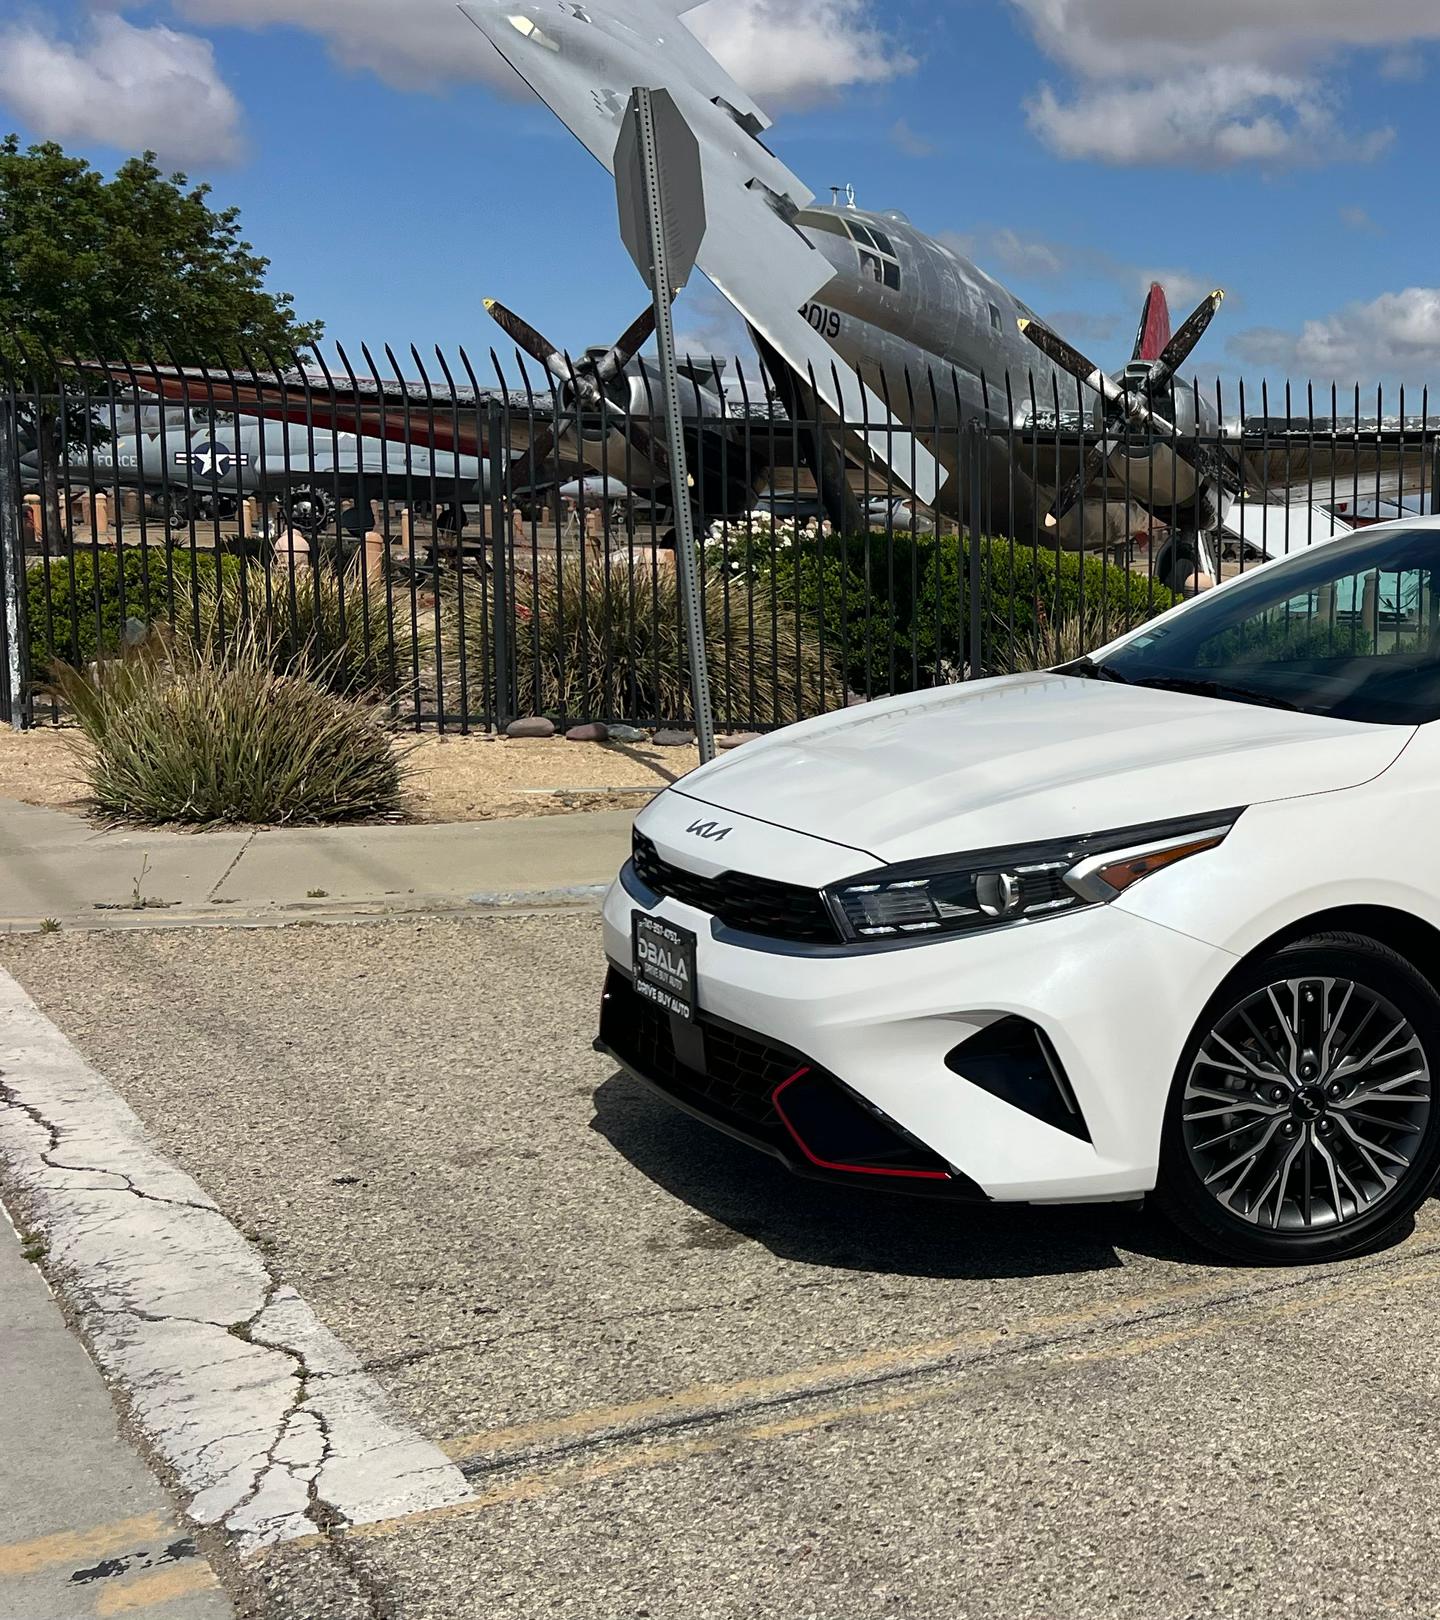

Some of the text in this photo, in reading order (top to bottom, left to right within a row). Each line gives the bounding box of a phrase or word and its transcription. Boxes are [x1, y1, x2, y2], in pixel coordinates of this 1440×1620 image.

[686, 818, 733, 842] KIA
[638, 937, 689, 982] DBALA
[658, 969, 670, 984] BUY
[669, 975, 683, 991] AUTO
[637, 979, 690, 1019] DRIVE BUY AUTO
